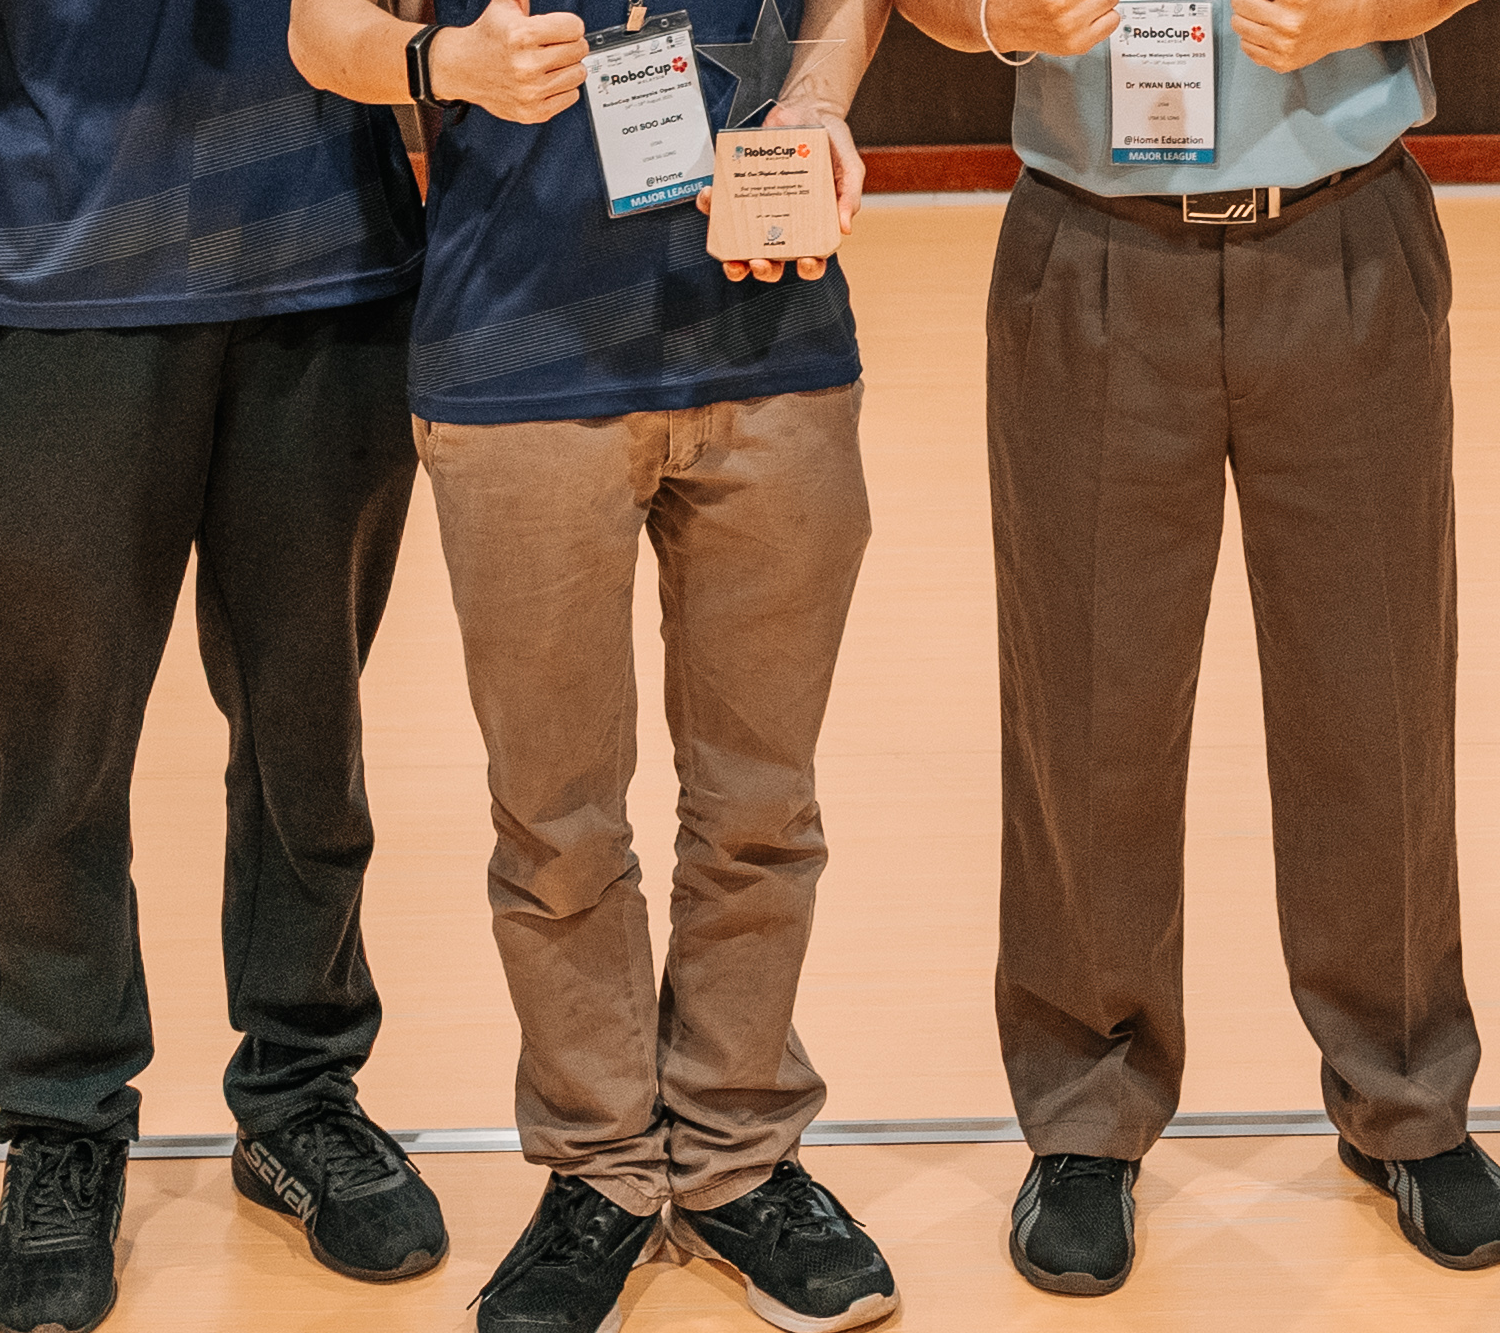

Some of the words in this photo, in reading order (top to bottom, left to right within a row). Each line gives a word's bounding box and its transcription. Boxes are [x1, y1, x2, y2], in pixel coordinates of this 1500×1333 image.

[1133, 27, 1189, 41] RoboCup
[611, 63, 671, 85] RoboCup
[622, 126, 638, 135] OOI
[639, 120, 658, 130] SOO
[660, 114, 683, 126] JACK
[1124, 136, 1159, 145] @Home
[1161, 136, 1203, 144] Education
[744, 146, 796, 157] RoboCup
[1129, 152, 1161, 160] MAJOR
[1164, 152, 1198, 161] LEAGUE
[646, 172, 683, 187] @Home
[630, 191, 666, 207] MAJOR
[667, 181, 704, 198] LEAGUE
[247, 1140, 319, 1223] SEVEN
